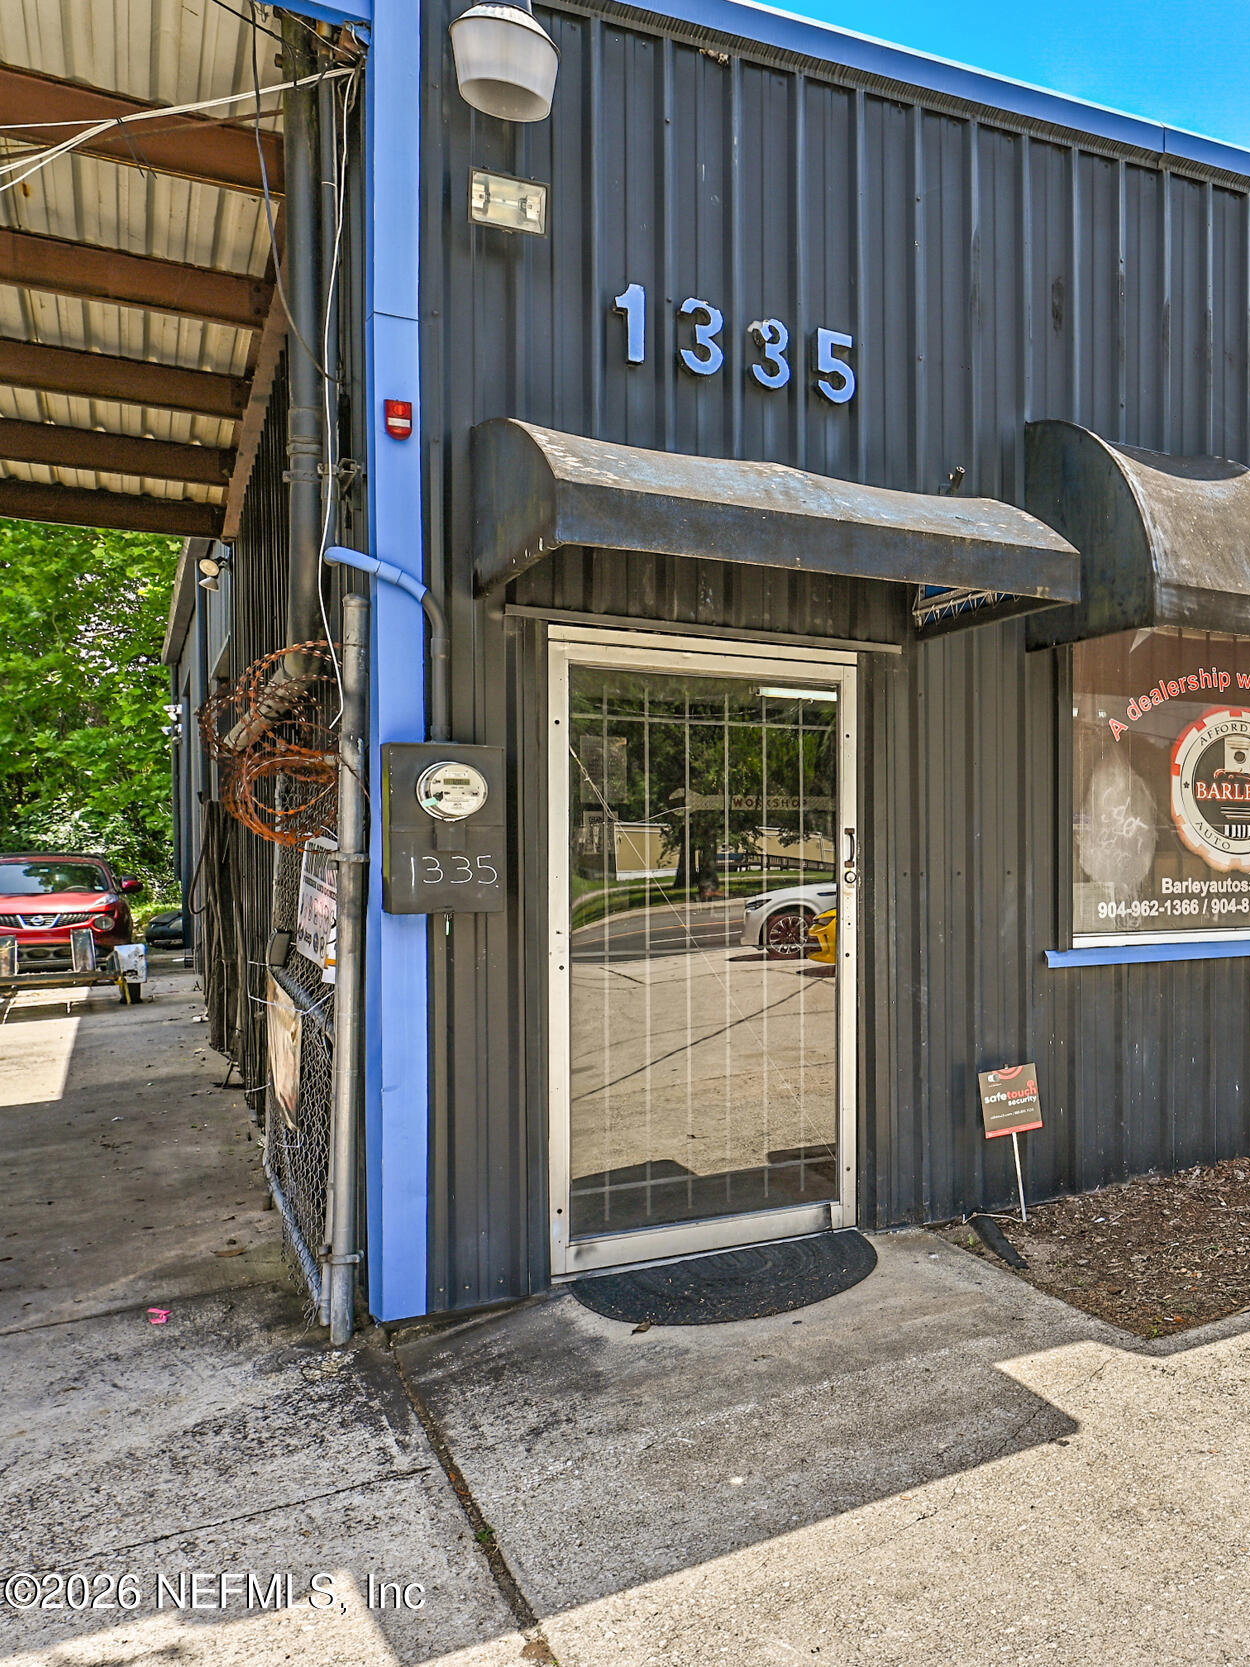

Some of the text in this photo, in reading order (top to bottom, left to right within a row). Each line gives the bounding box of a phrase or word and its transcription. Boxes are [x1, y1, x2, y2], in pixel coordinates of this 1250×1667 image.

[613, 283, 857, 405] 1335
[1108, 718, 1129, 742] A
[1126, 667, 1231, 721] dealership
[1195, 821, 1231, 850] AUTO
[410, 855, 498, 889] 1335
[1097, 899, 1199, 919] 904-962-1366
[1008, 1095, 1037, 1106] security
